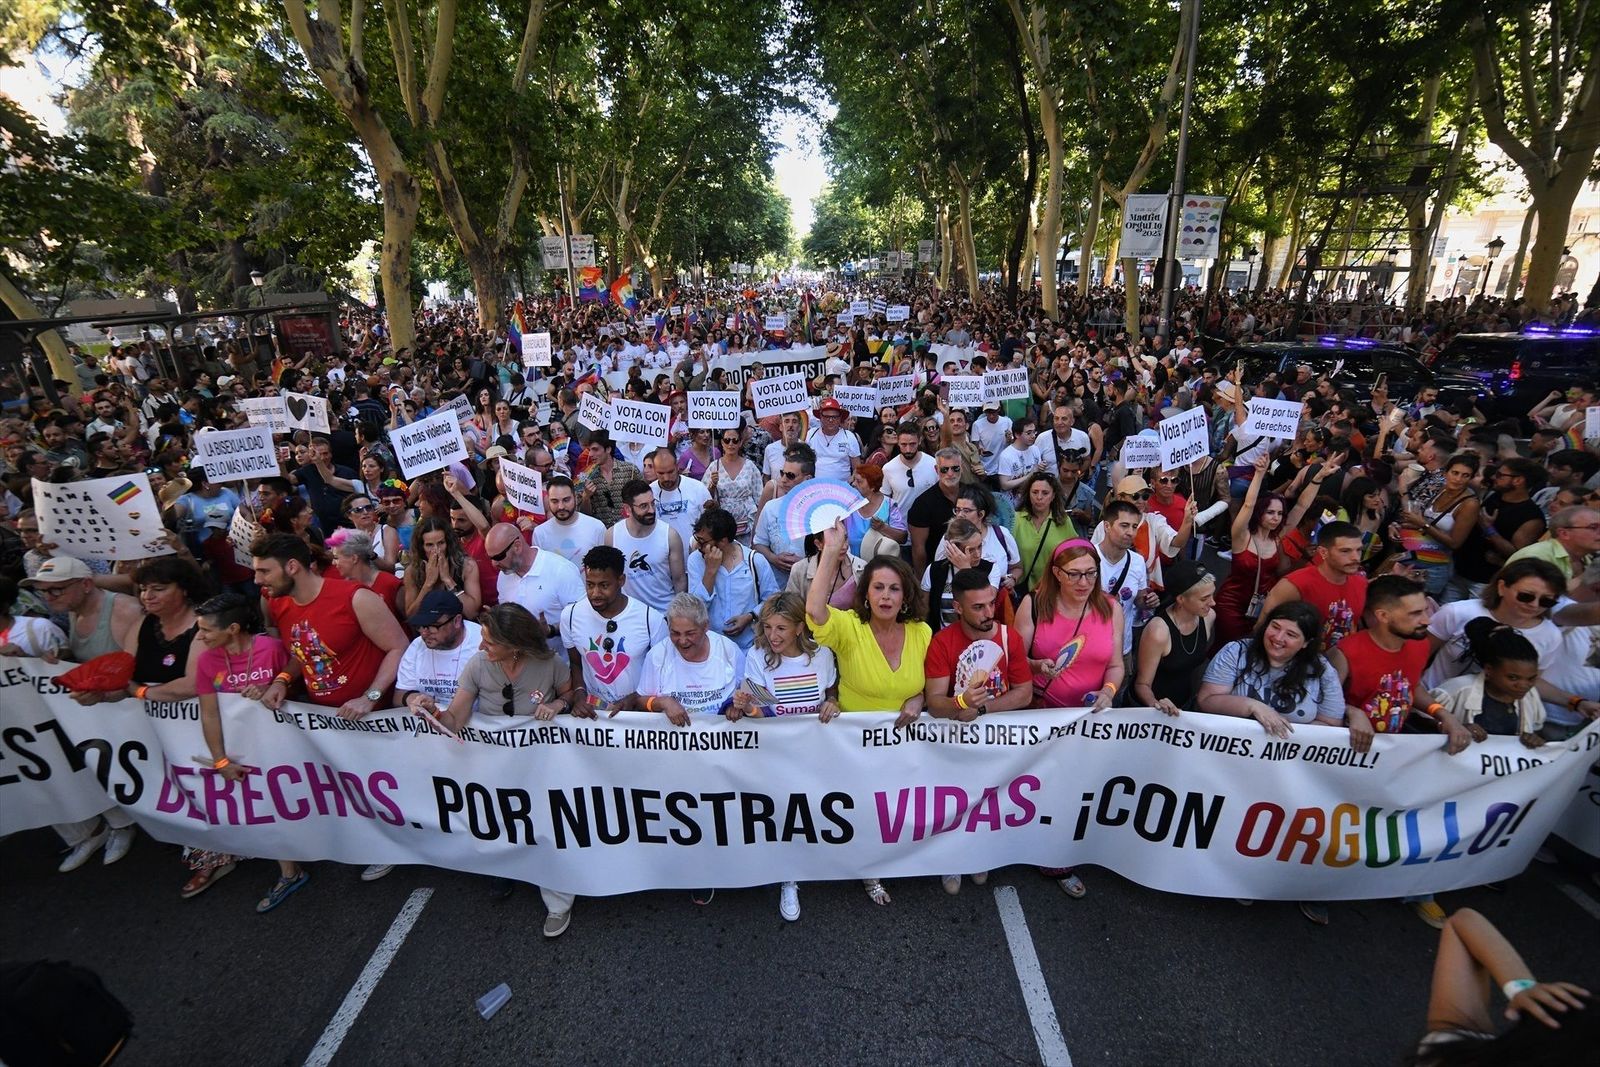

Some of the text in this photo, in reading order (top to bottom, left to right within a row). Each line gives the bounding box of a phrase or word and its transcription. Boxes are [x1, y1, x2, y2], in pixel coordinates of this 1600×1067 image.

[1130, 212, 1160, 221] Madrid
[756, 379, 804, 396] VOTA CON
[879, 378, 913, 391] Vota por tus
[984, 372, 1027, 387] CURAS NO CASAN
[758, 392, 806, 410] ORGULLO!
[835, 390, 875, 402] Vota por tus
[880, 394, 909, 405] derechos.
[985, 387, 995, 398] CON
[585, 398, 603, 416] VOTA
[692, 397, 738, 408] VOTA CON
[1251, 403, 1300, 419] Vota por tus
[581, 409, 609, 430] ORGUL
[616, 405, 643, 419] VOTA
[644, 410, 667, 424] CON
[692, 410, 738, 422] ORGULLO!
[411, 429, 426, 445] más
[425, 419, 452, 441] violencia
[613, 420, 666, 439] ORGULLO!
[1161, 414, 1206, 442] Vota por tus
[1254, 419, 1294, 433] derechos.
[203, 435, 265, 457] LA BISEXUALIDAD
[401, 437, 461, 469] homófoba y racista!
[1170, 440, 1205, 465] derechos.
[205, 454, 276, 478] ES LO MÁS NATURAL
[307, 713, 400, 733] ESKUBIDEEN
[480, 726, 572, 748] BIZITZAREN
[576, 728, 620, 748] ALDE.
[624, 729, 759, 751] HARROTASUNEZ!
[862, 720, 1380, 770] PELS NOSTRES DRETS. PER LES NOSTRES VIDES. AMB ORGULL!
[156, 758, 422, 830] DERECHOS.
[432, 775, 538, 847] POR
[547, 785, 855, 850] NUESTRAS
[873, 774, 1052, 844] VIDAS.
[1073, 775, 1226, 850] ¡CON
[1234, 798, 1538, 868] ORGULLO!
